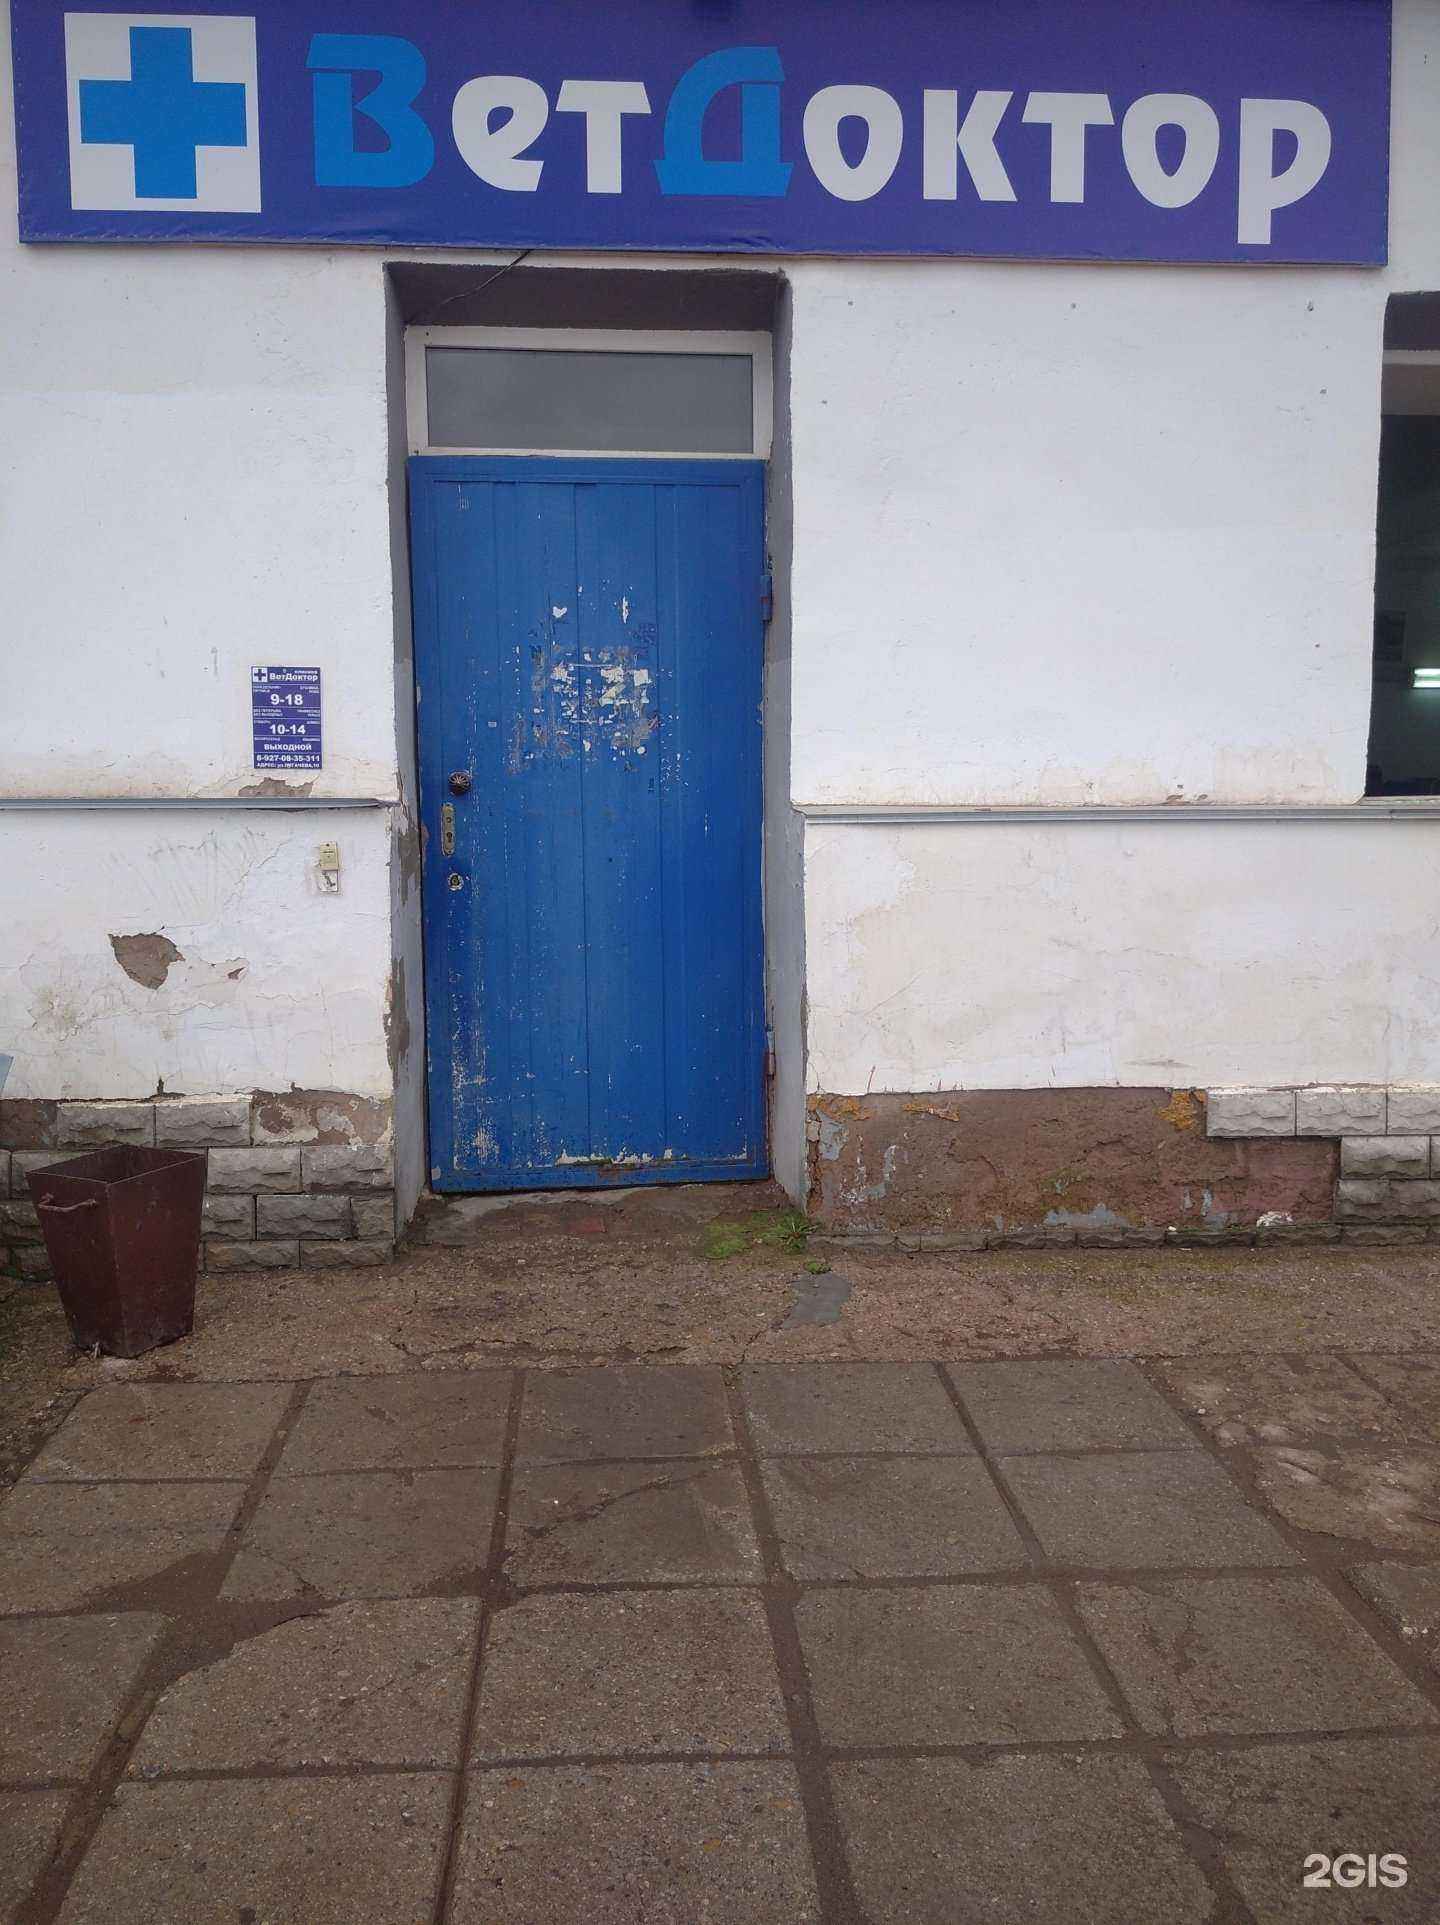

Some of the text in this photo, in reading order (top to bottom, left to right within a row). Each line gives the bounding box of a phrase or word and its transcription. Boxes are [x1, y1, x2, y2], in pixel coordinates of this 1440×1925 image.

[305, 33, 1333, 246] ВетДоктор
[270, 673, 318, 682] ВетДоктор
[270, 694, 303, 705] 9-18
[269, 724, 306, 734] 10-14
